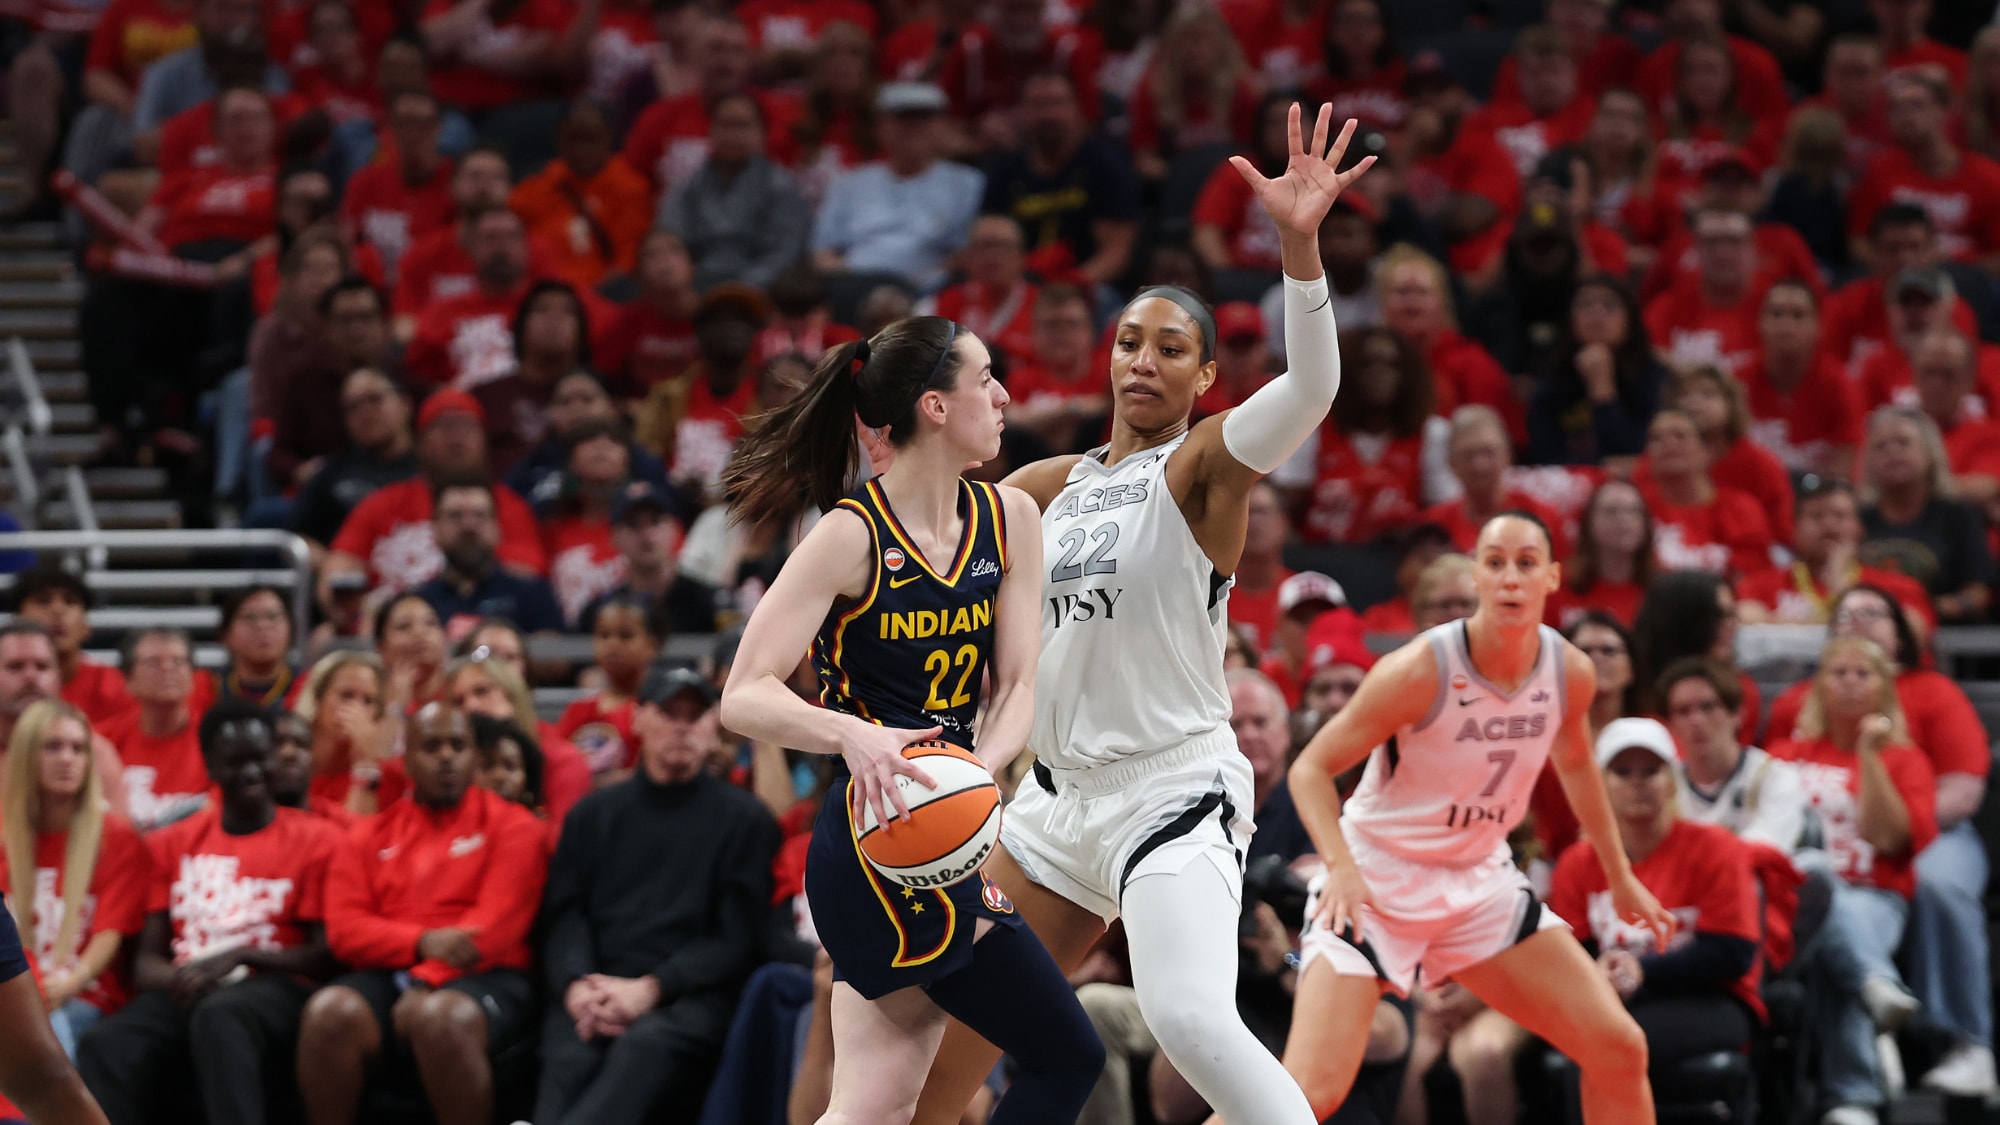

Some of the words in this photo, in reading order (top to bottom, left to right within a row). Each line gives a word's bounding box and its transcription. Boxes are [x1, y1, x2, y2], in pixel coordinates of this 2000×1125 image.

[1054, 478, 1150, 521] ACES
[970, 557, 1000, 578] Lilly
[1051, 521, 1120, 583] 22
[879, 593, 995, 640] INDIAN
[923, 643, 979, 711] 22
[1455, 713, 1547, 741] ACES
[1479, 749, 1517, 797] 7
[897, 842, 992, 888] Wilson
